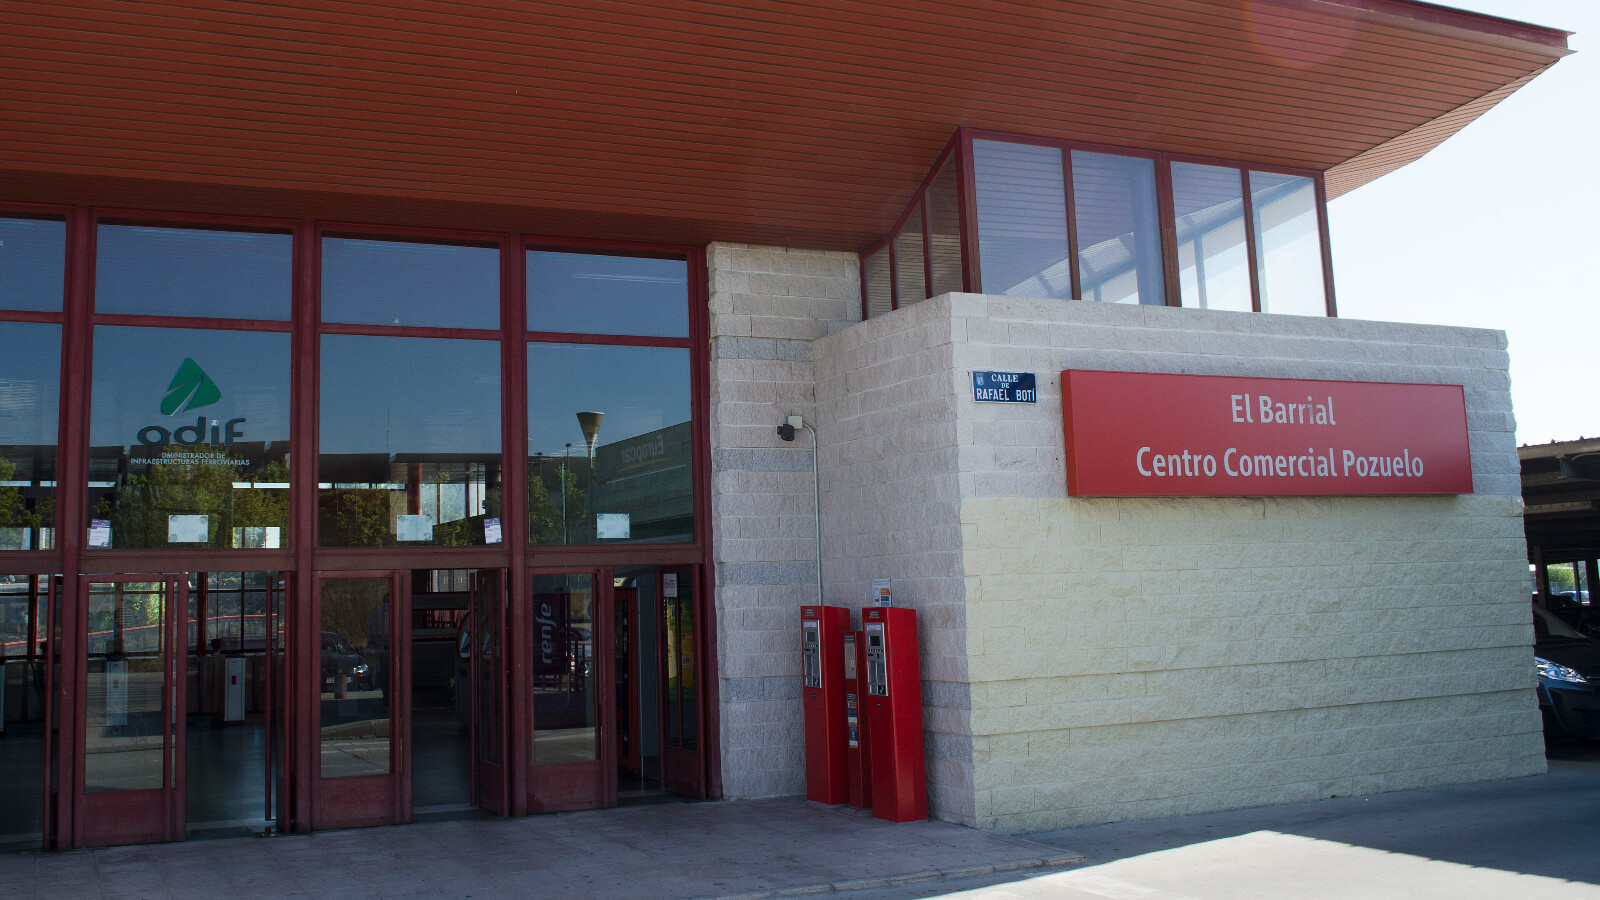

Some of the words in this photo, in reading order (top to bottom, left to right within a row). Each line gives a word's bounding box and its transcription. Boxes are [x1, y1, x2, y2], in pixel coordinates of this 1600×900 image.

[991, 374, 1019, 382] CALLE
[976, 389, 1009, 401] RAFAEL
[1016, 388, 1035, 402] BOTÍ
[1231, 393, 1254, 424] El
[1259, 394, 1336, 426] Barrial
[137, 417, 246, 445] adif
[1136, 446, 1217, 477] Centro
[1223, 447, 1340, 478] Comercial
[1343, 448, 1424, 478] Pozuelo
[534, 603, 558, 664] renfe
